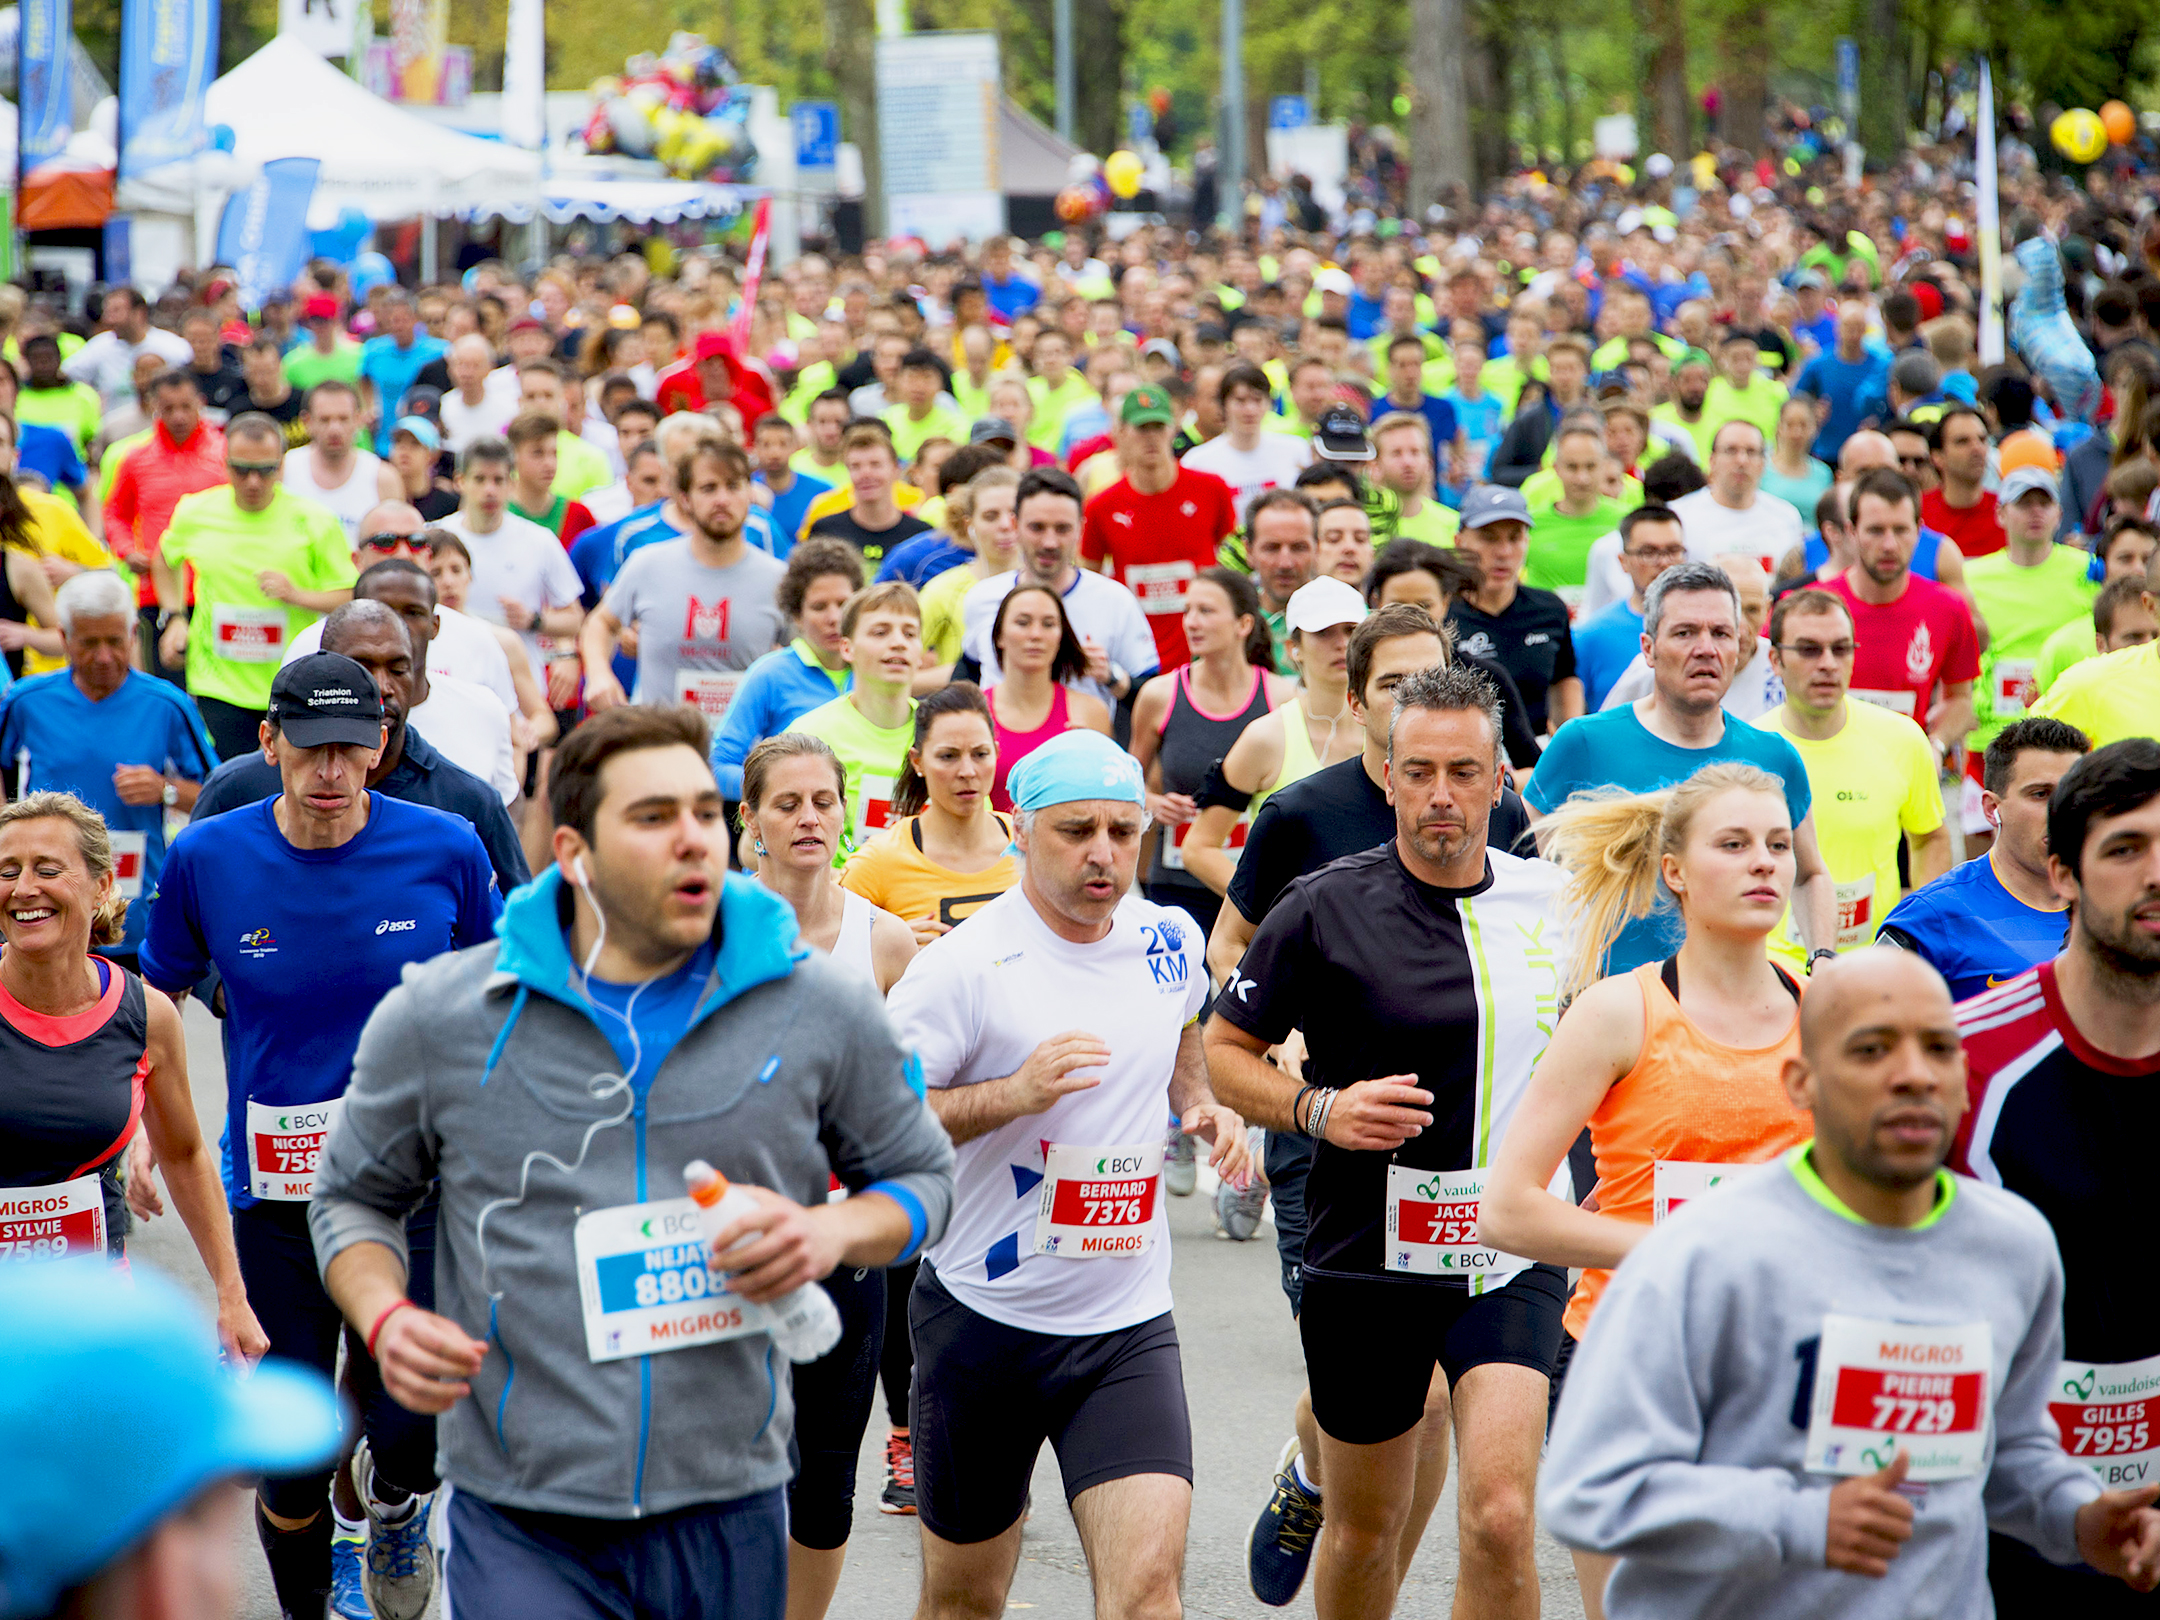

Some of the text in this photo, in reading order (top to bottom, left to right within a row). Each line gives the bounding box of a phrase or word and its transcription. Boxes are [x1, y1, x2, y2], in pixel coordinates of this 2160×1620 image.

[307, 697, 359, 706] Schwarzsee
[312, 687, 352, 698] Triathlon
[388, 919, 416, 932] asics
[1147, 953, 1188, 984] KM
[294, 1112, 329, 1129] BCV
[1112, 1157, 1143, 1173] BCV
[1079, 1181, 1147, 1198] BERNARD
[0, 1195, 69, 1216] MIGROS
[1082, 1199, 1141, 1225] 7376
[2, 1219, 62, 1238] SYLVIE
[0, 1235, 69, 1262] 7589
[1081, 1235, 1143, 1251] MIGROS
[1460, 1252, 1498, 1268] BCV
[650, 1307, 743, 1341] MIGROS
[1879, 1341, 1964, 1364] MIGROS
[1883, 1374, 1954, 1397] PIERRE
[1872, 1396, 1956, 1432] 7729
[2082, 1403, 2146, 1424] GILLES
[2073, 1421, 2150, 1454] 7955
[2109, 1461, 2149, 1484] BCV
